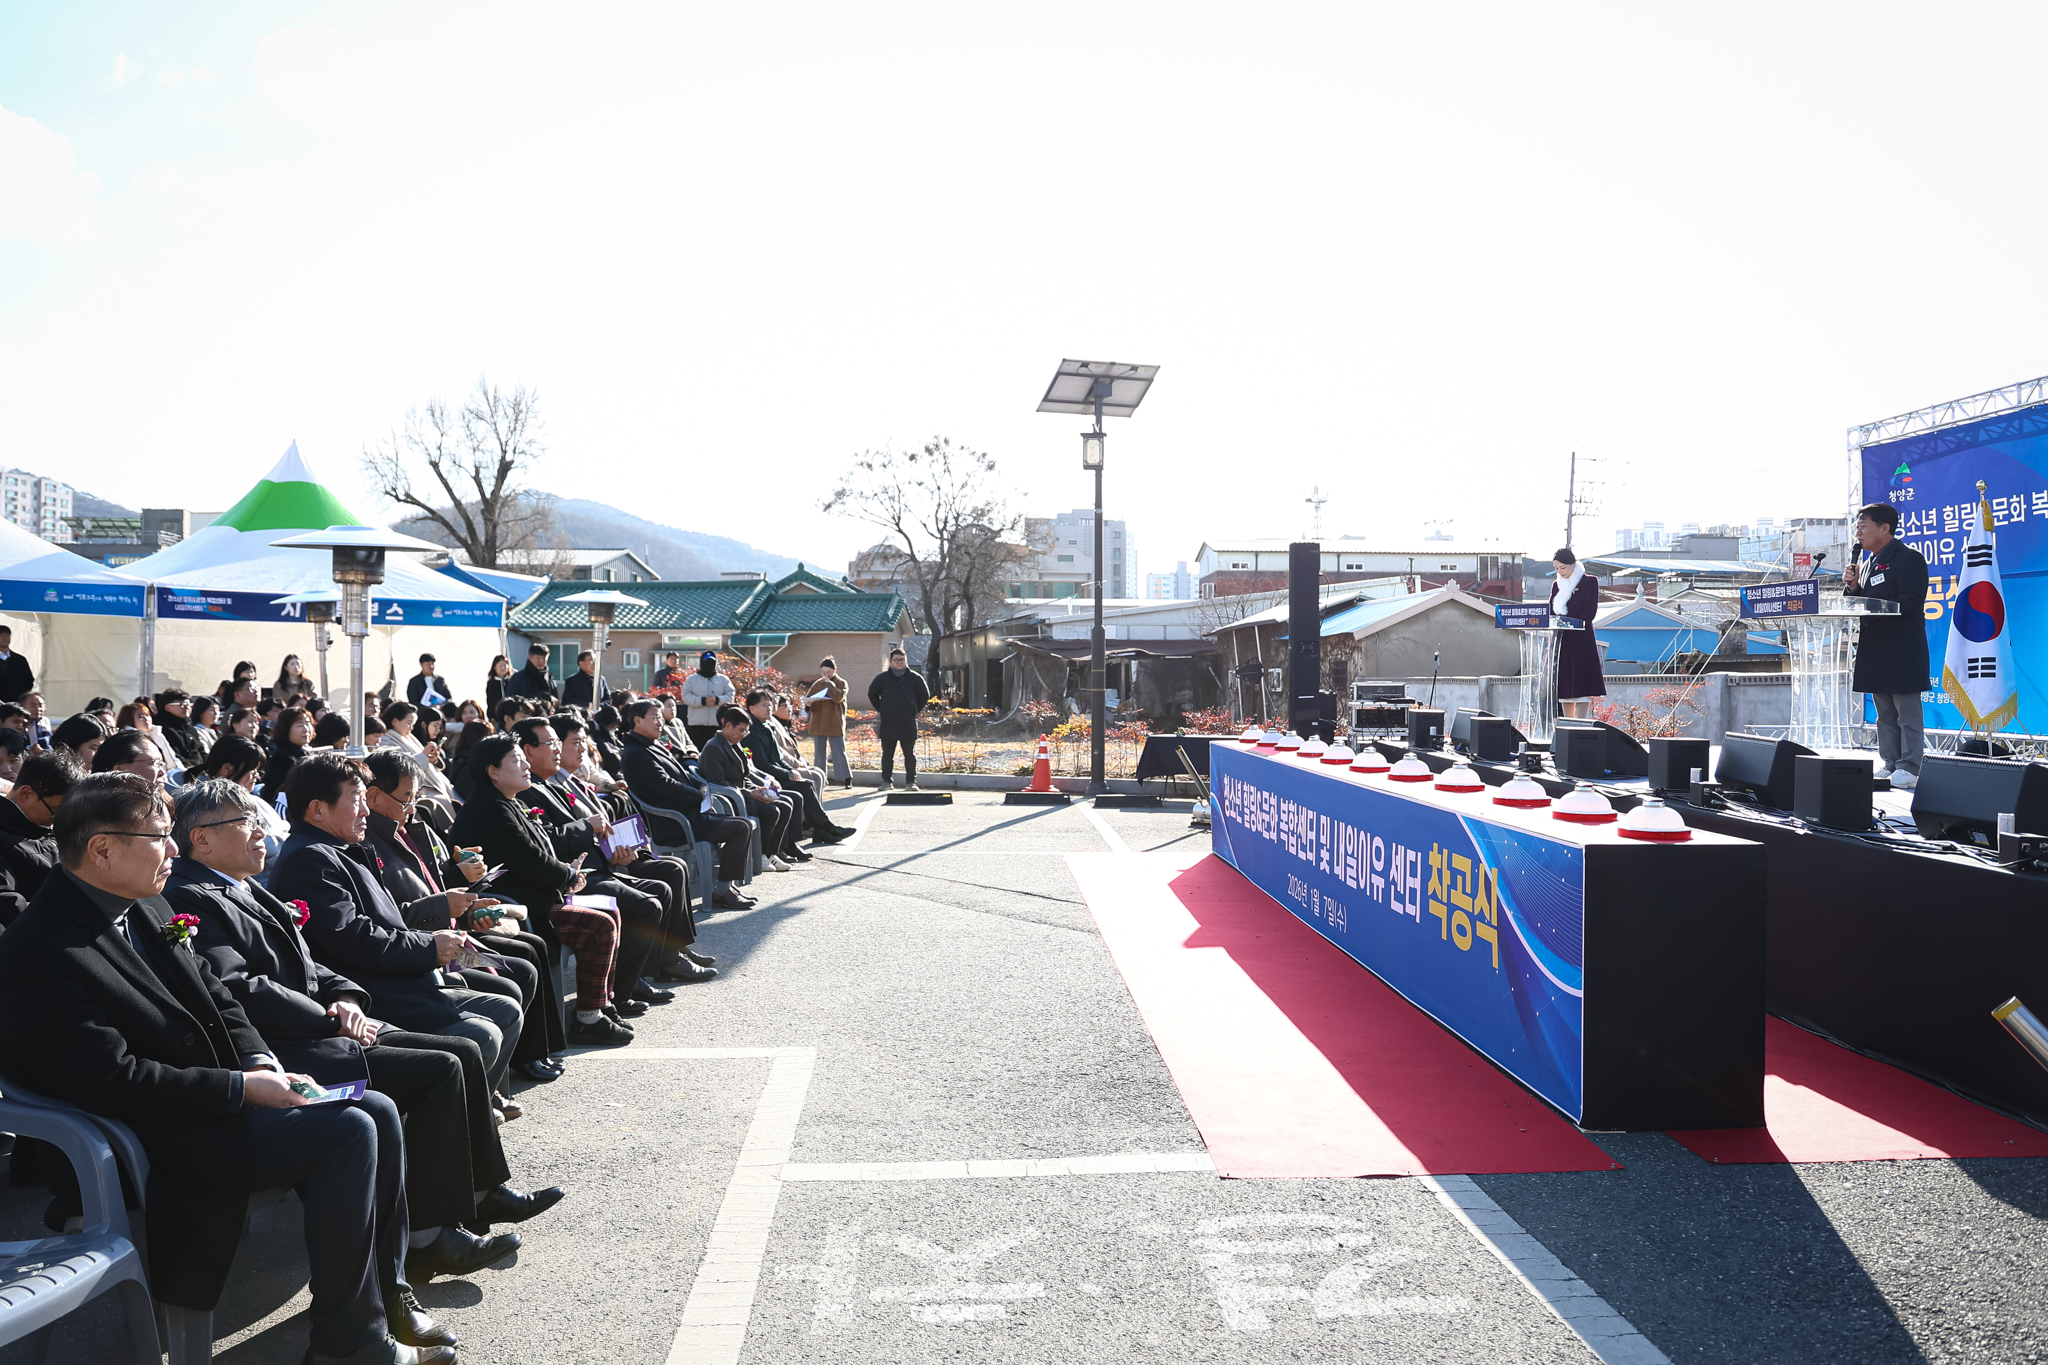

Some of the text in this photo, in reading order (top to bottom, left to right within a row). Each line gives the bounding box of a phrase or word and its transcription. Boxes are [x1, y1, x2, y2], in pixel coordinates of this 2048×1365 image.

[1888, 488, 1915, 503] 청양군
[1808, 583, 1814, 595] 및
[1787, 600, 1803, 611] 착공식
[1223, 774, 1499, 970] 청소년 힐링&문화 복합센터 및 내일이유 센터 착공식
[1287, 873, 1347, 933] 2026년 1월 7일(수)
